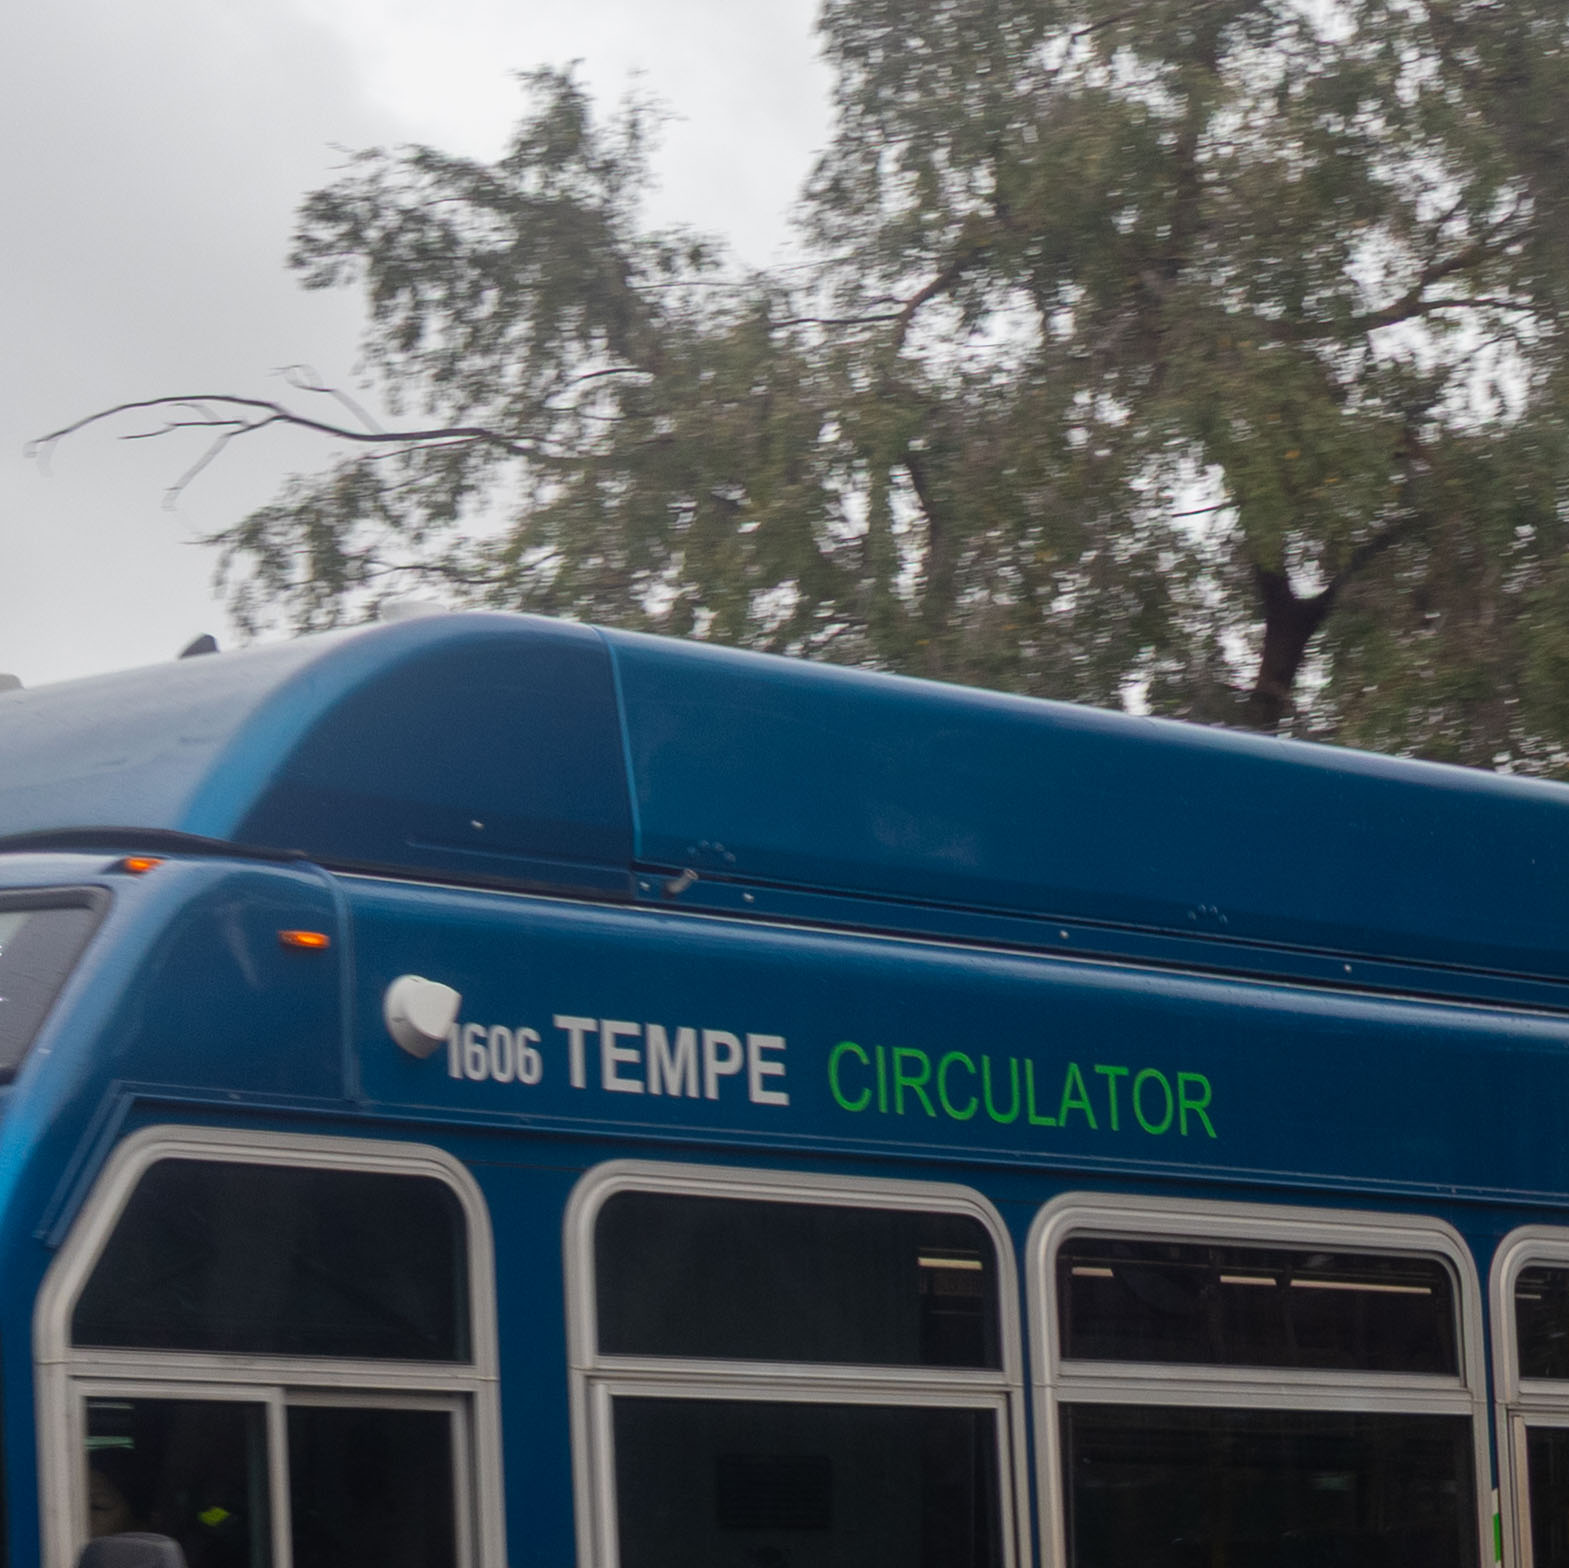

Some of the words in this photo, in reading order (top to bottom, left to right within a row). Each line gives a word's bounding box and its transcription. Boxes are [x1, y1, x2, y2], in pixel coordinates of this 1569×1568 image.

[446, 1022, 542, 1084] 1606
[554, 1015, 790, 1106] TEMPE
[828, 1042, 1217, 1138] CIRCULATOR
